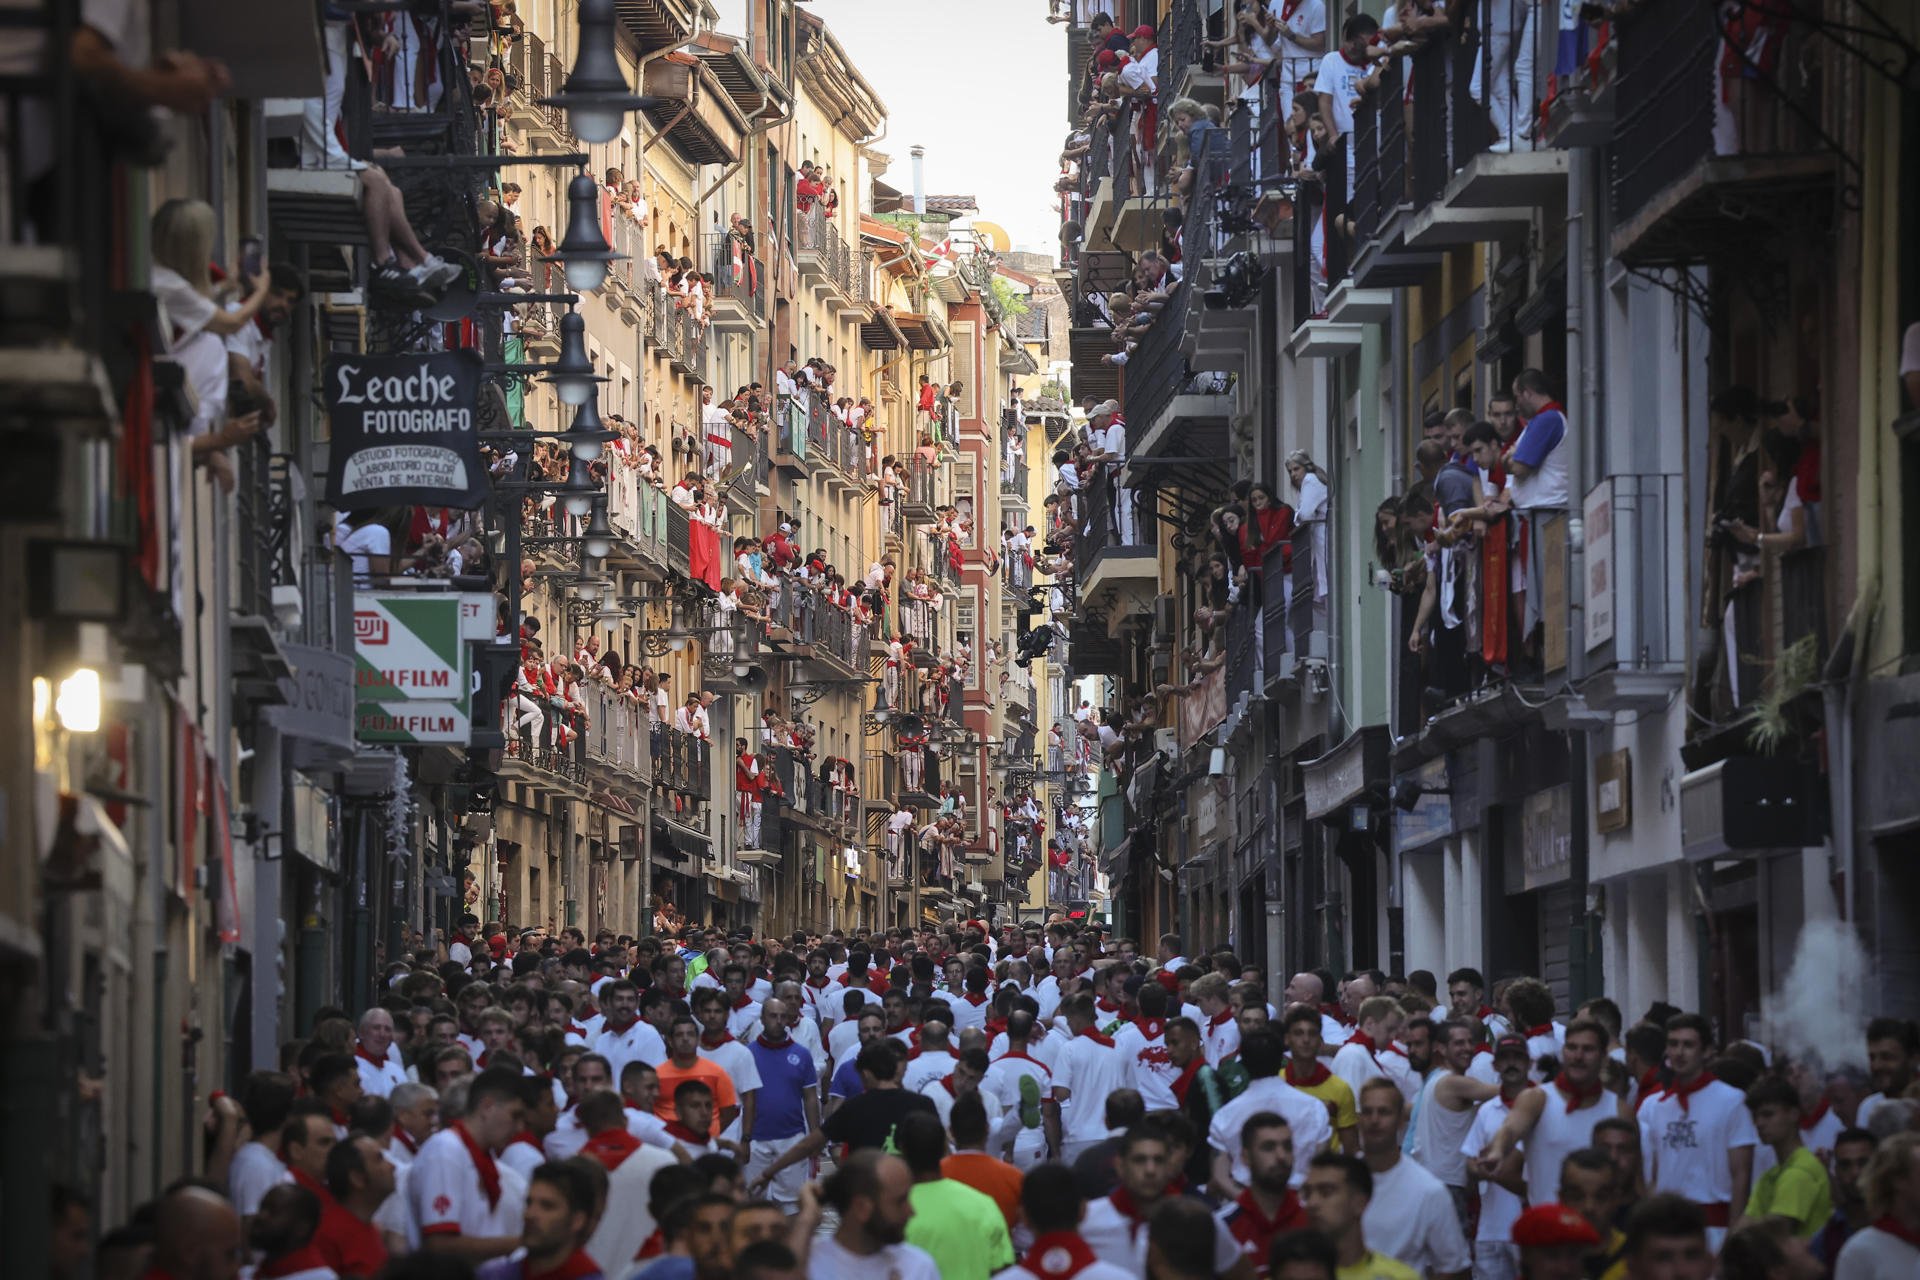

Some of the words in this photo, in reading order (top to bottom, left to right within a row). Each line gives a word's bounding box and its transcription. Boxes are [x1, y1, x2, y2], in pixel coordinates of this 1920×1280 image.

[337, 363, 456, 406] Leache
[363, 408, 470, 434] FOTOGRAFO
[351, 449, 392, 466] ESTUDIO
[358, 460, 421, 477] LABORATORIO
[424, 461, 456, 475] COLOR
[352, 476, 384, 490] VENTA
[389, 475, 401, 486] DE
[406, 474, 456, 488] MATERIAL
[358, 669, 449, 687] UJIFILM
[360, 716, 455, 733] FUJIFILM
